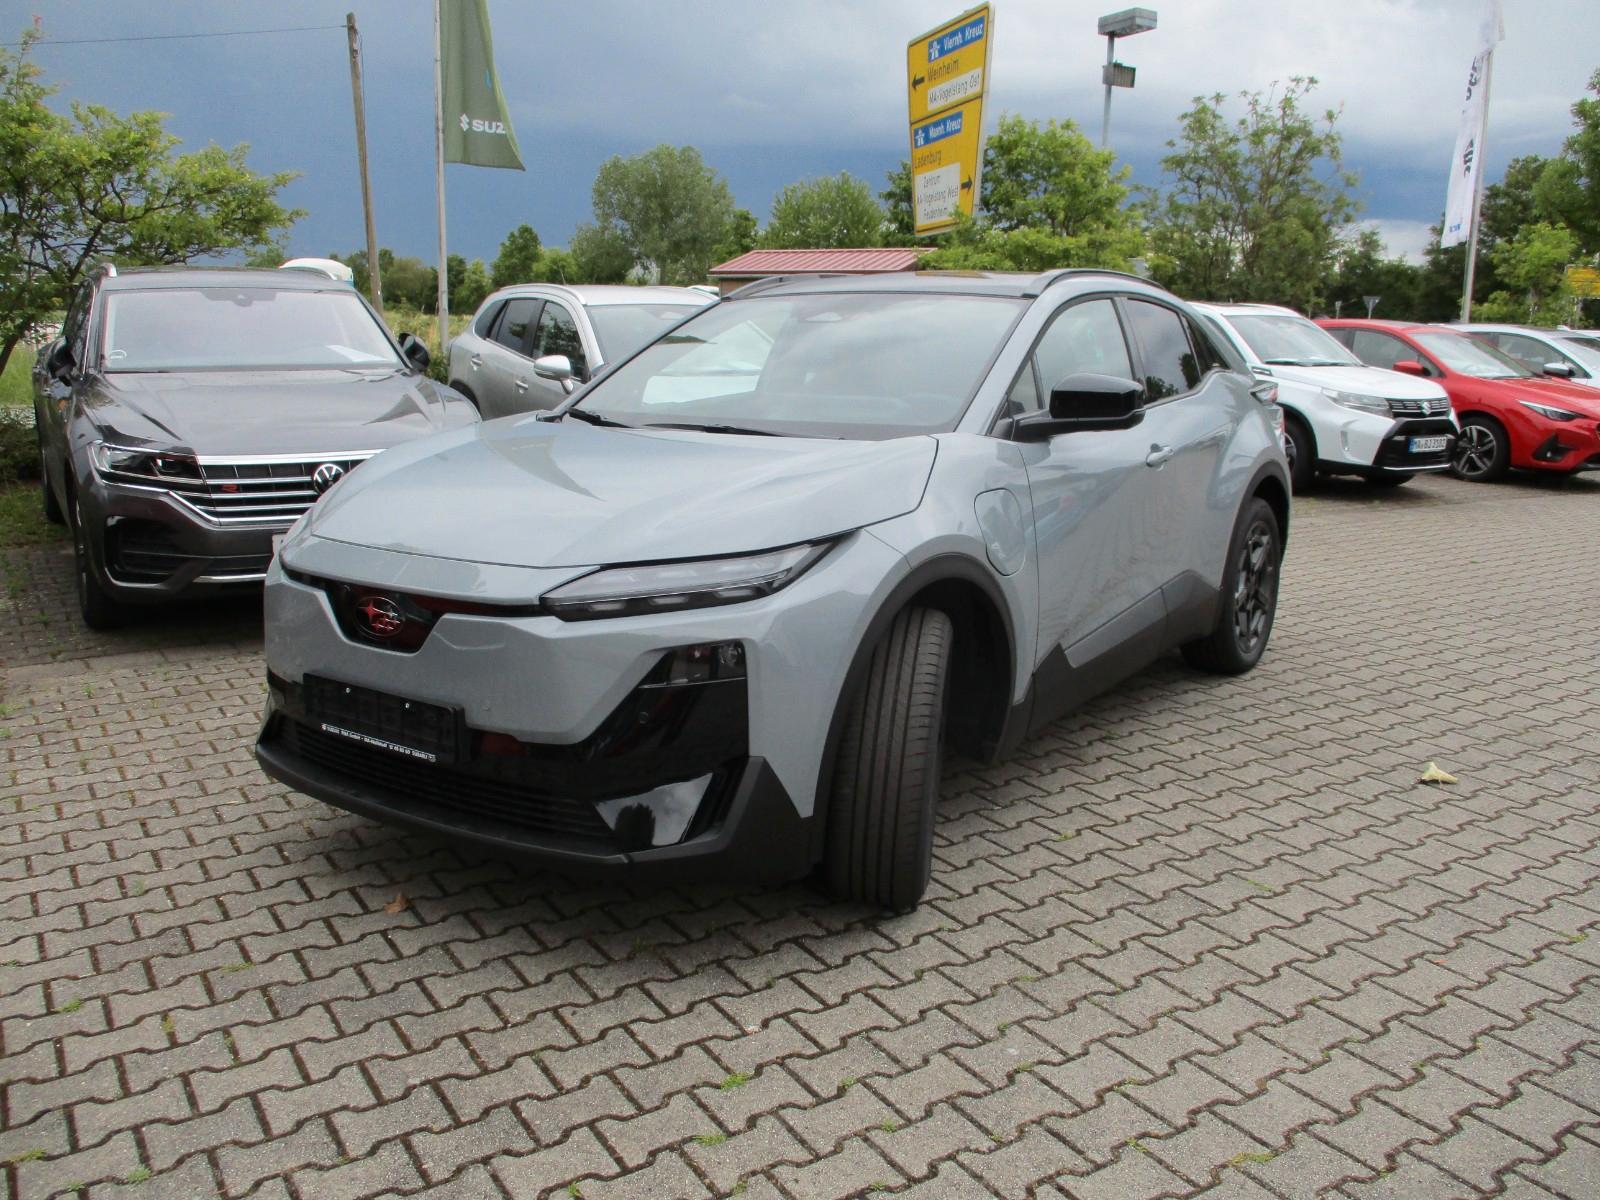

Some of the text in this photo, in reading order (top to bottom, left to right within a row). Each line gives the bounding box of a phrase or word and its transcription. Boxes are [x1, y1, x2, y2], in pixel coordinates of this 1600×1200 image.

[965, 24, 984, 40] Kreuz
[928, 59, 959, 81] Weinheim
[969, 73, 980, 88] Ost
[946, 118, 962, 132] Kreuz
